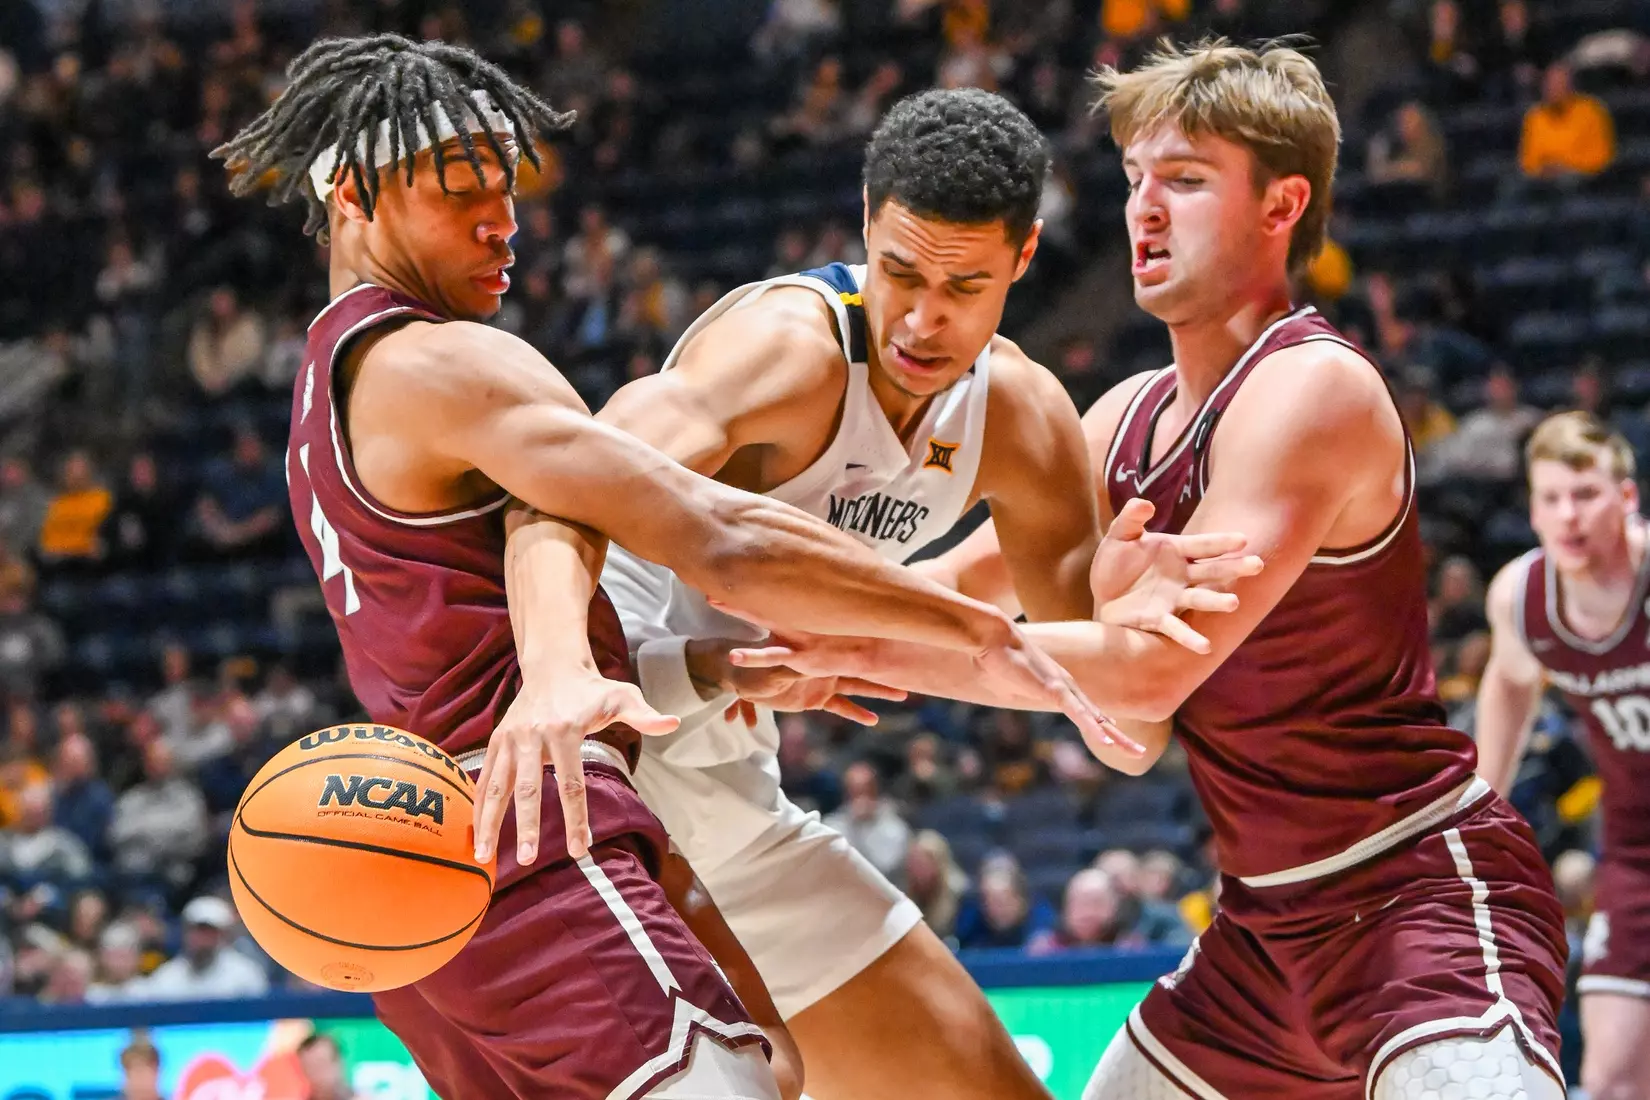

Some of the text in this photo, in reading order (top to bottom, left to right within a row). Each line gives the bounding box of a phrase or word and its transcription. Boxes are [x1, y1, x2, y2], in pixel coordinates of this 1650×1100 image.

[923, 439, 957, 473] XII
[1590, 696, 1650, 752] 10
[299, 726, 470, 787] Wilson
[317, 773, 444, 827] NCAA
[317, 810, 443, 837] OFFICIAL GAME BALL
